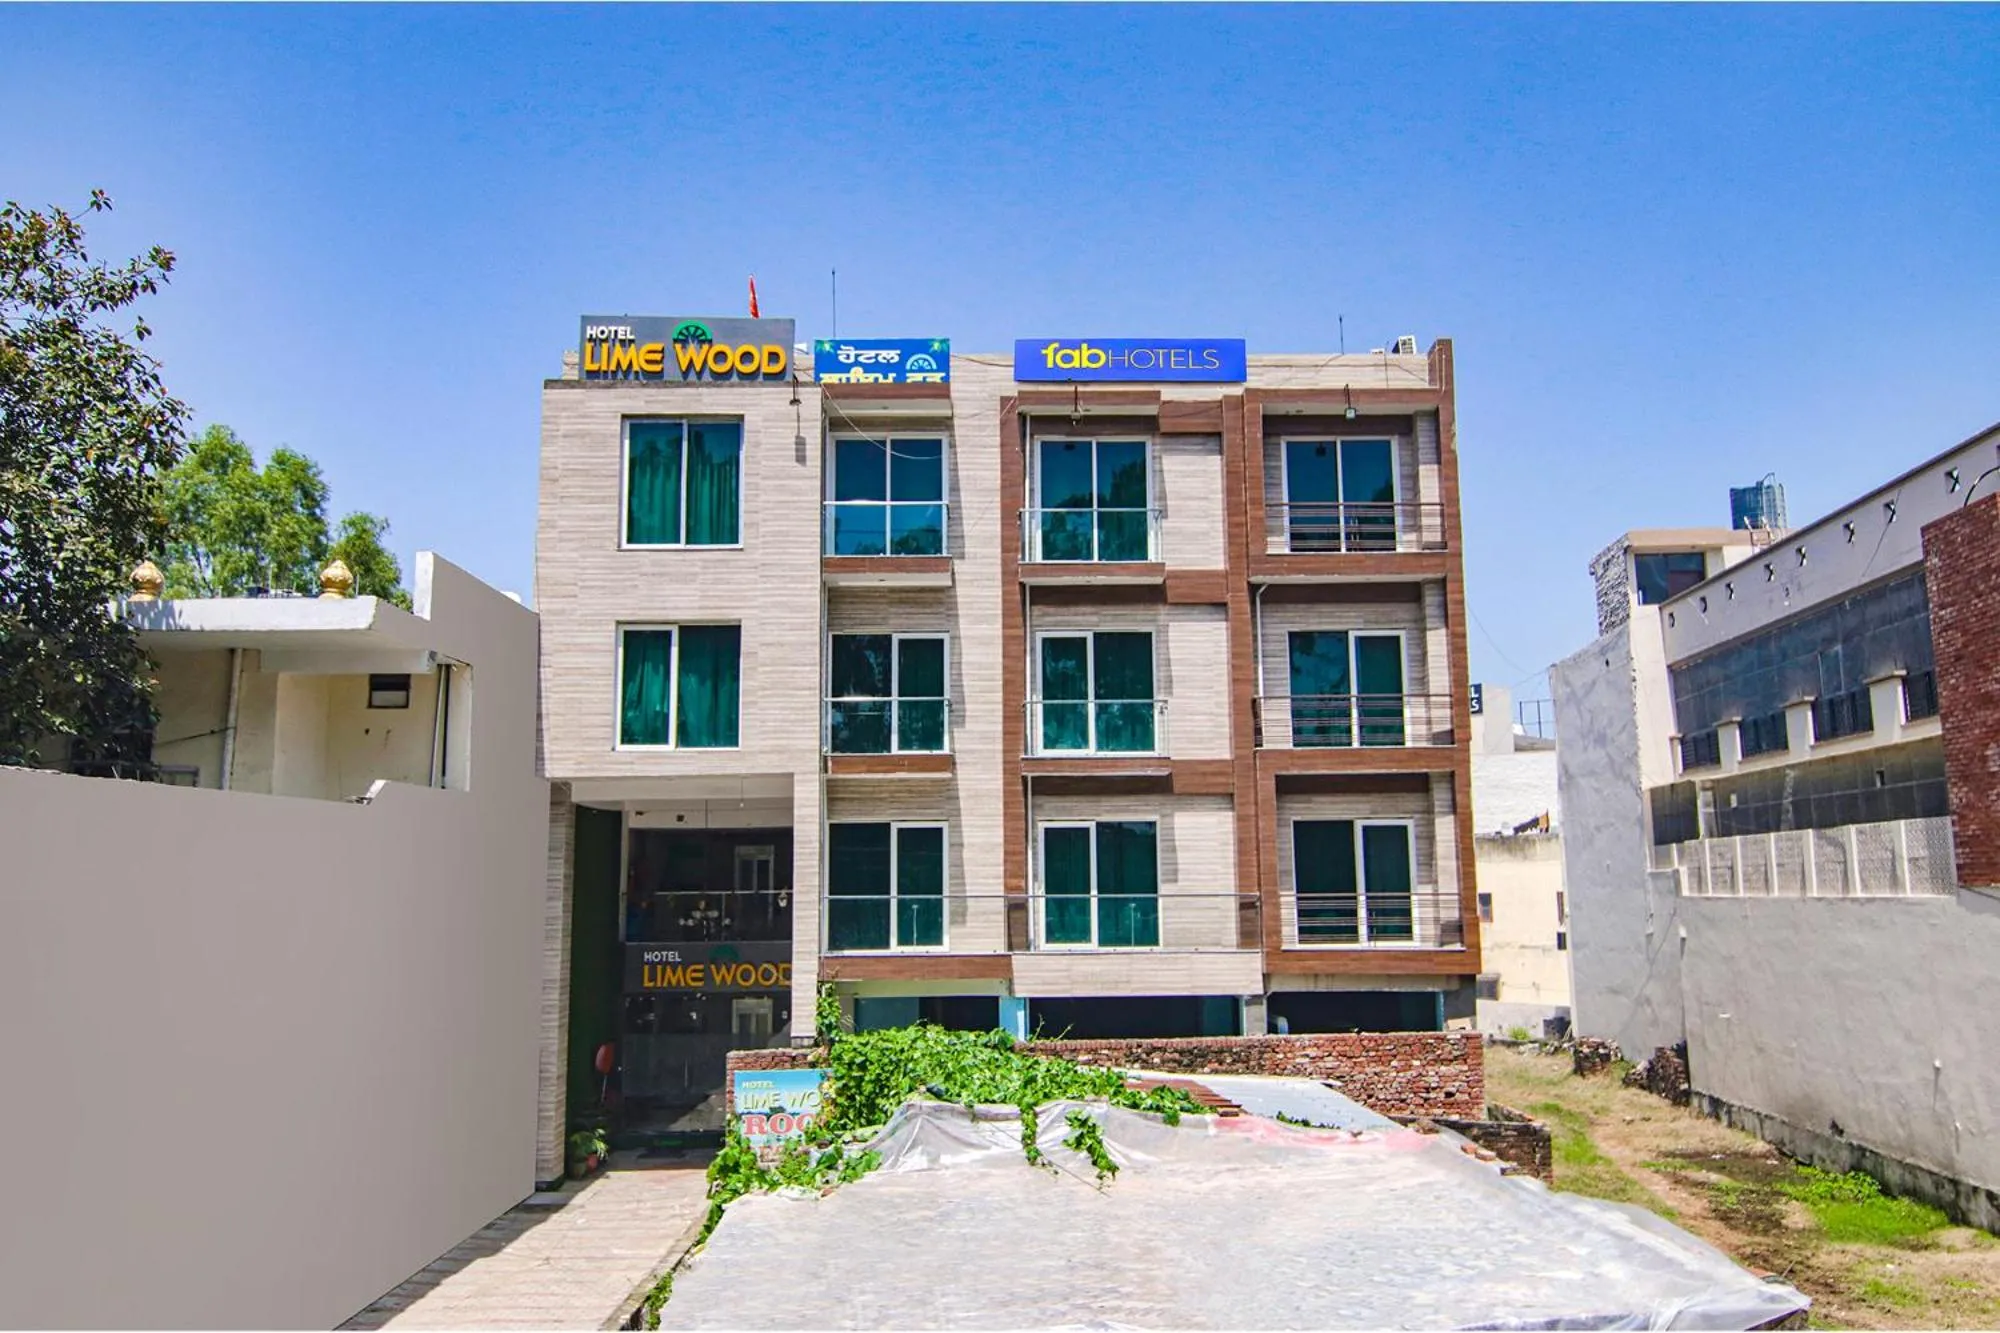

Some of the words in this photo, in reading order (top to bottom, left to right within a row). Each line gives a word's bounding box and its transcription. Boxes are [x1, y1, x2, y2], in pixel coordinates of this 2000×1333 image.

[586, 325, 635, 339] HOTEL
[583, 342, 665, 373] LIME
[674, 343, 787, 374] WOOD
[837, 344, 901, 364] ਹੋਟਲ
[1041, 342, 1220, 369] fabHOTELS
[644, 951, 682, 962] HOTEL
[642, 963, 704, 988] LIME
[709, 962, 792, 987] WOOD
[742, 1080, 774, 1089] HOTEL
[743, 1091, 780, 1109] LIME
[786, 1090, 821, 1108] WO
